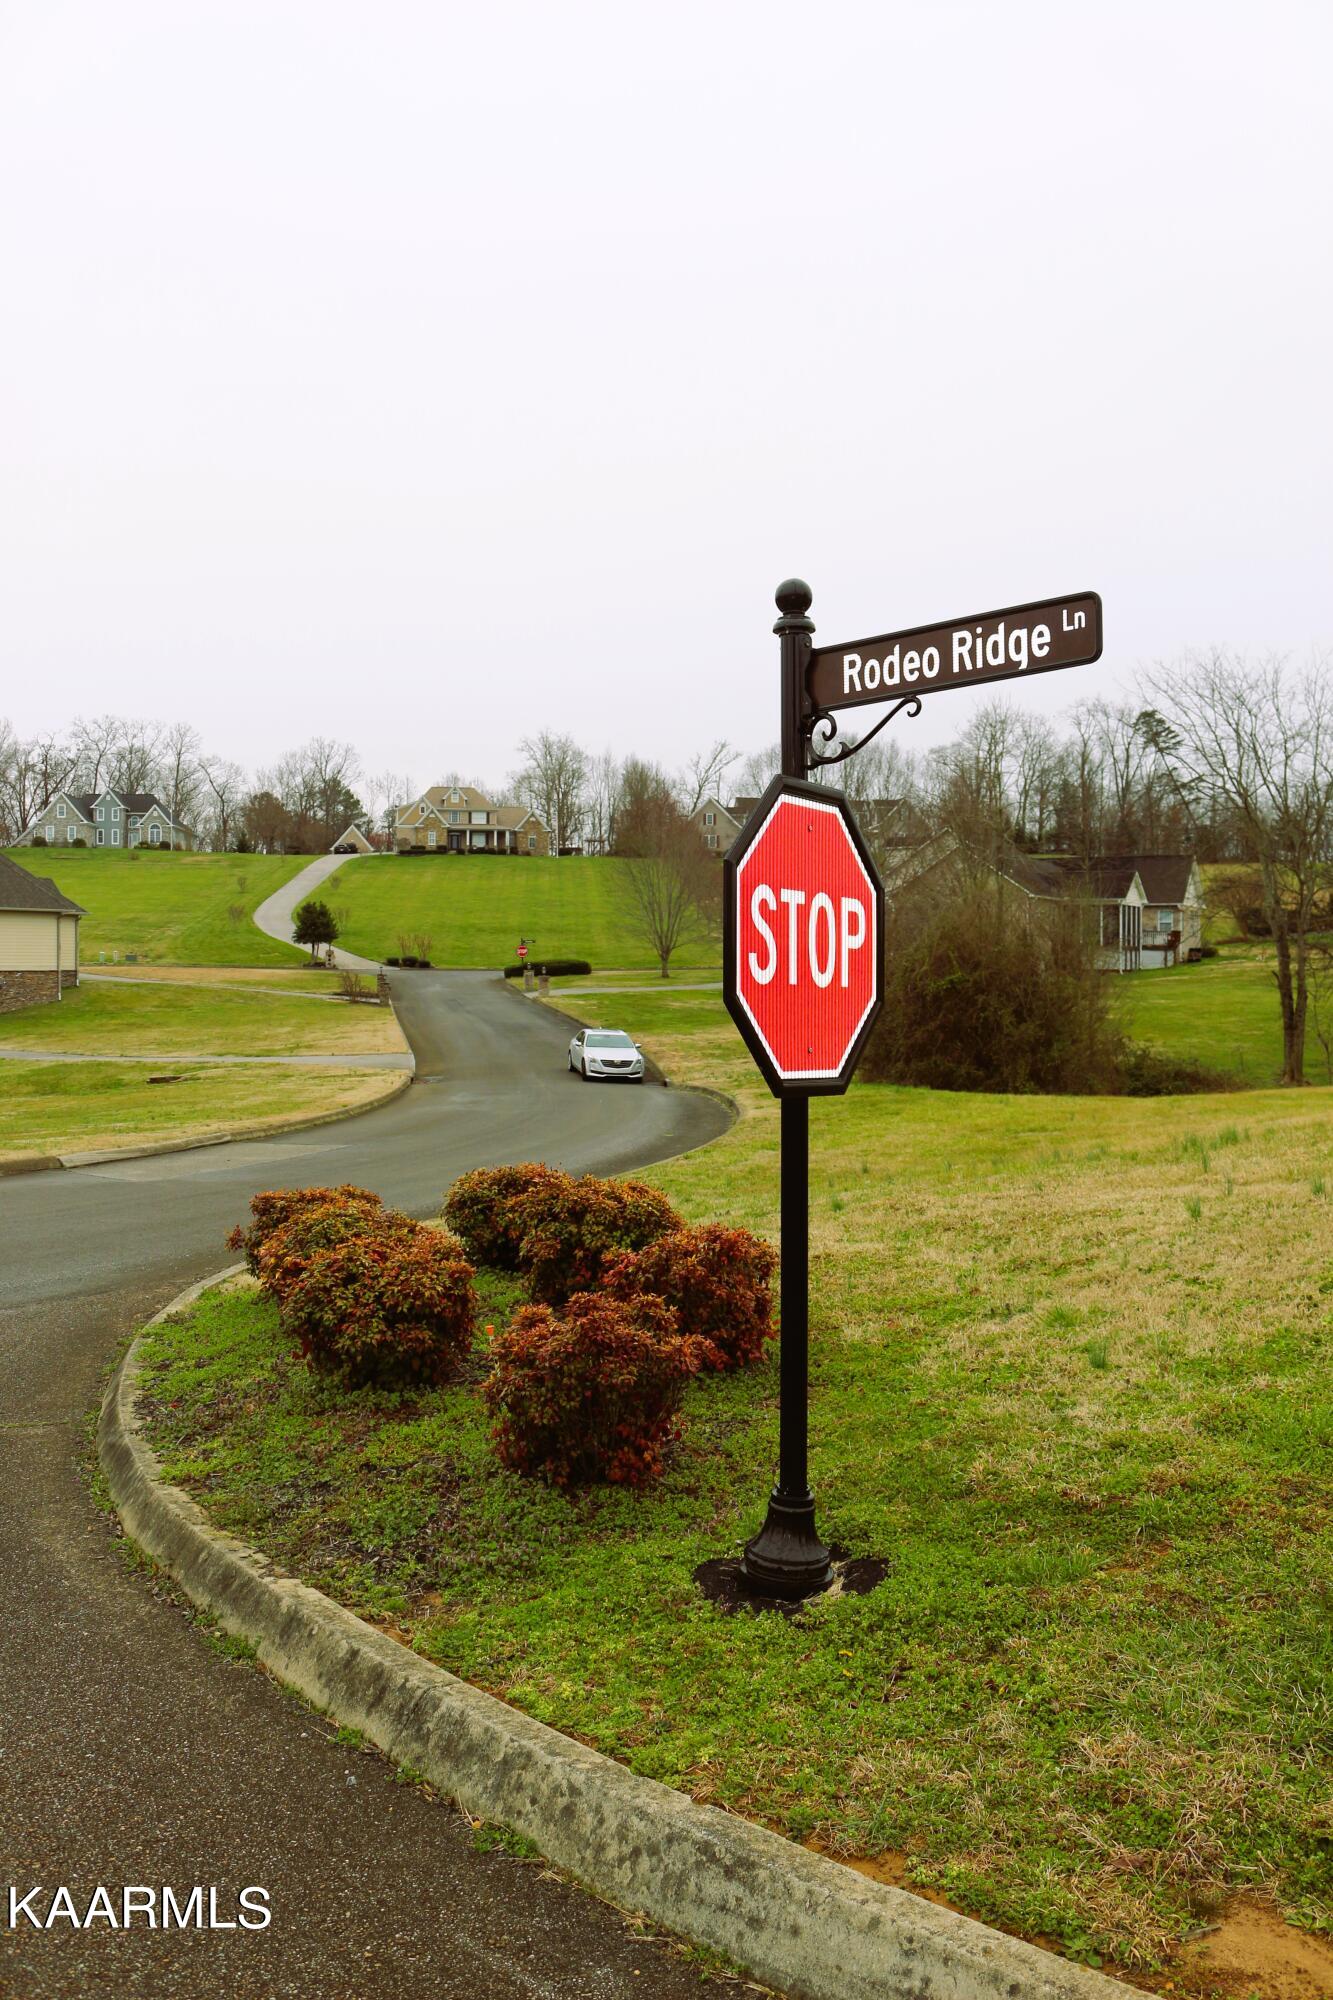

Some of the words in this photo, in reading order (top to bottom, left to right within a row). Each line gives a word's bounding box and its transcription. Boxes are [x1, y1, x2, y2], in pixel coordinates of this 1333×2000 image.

[843, 644, 940, 694] Rodeo
[952, 622, 1051, 670] Ridge
[1062, 609, 1086, 632] Ln
[748, 884, 866, 988] STOP
